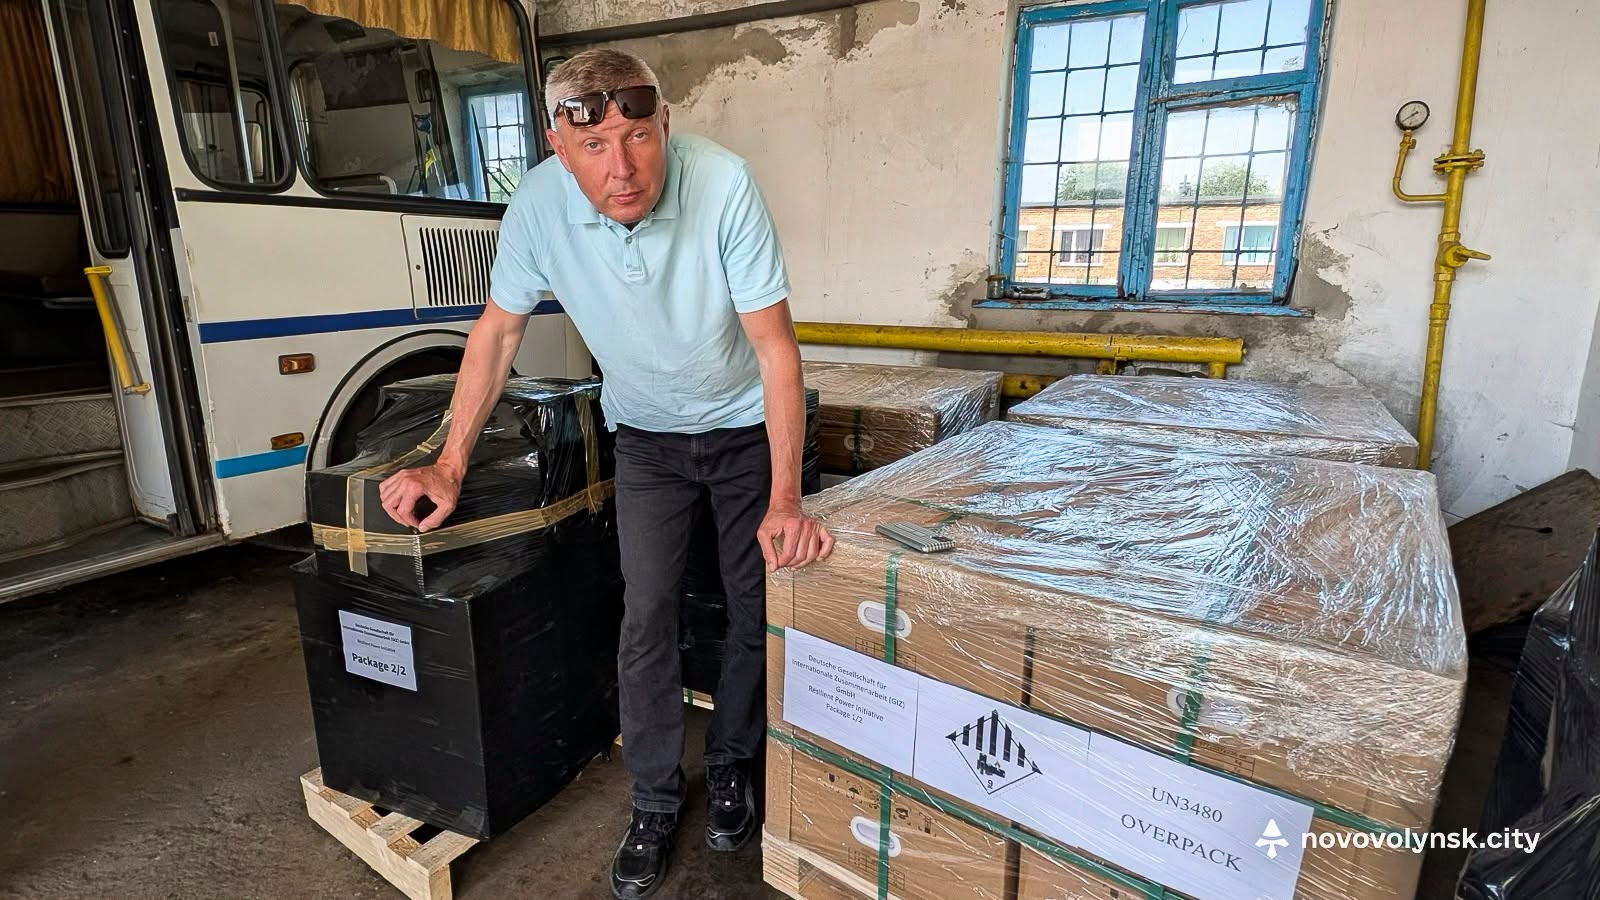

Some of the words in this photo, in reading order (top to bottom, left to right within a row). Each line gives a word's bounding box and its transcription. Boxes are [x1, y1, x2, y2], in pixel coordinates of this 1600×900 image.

[351, 652, 389, 673] Package
[390, 663, 407, 676] 2/2
[808, 654, 836, 671] Deutsche
[837, 666, 876, 686] Gesellschaft
[876, 681, 887, 690] für
[792, 659, 833, 680] Internationale
[834, 672, 888, 702] Zusammenarbeit
[889, 696, 905, 709] (GIZ)
[808, 685, 834, 700] Resilient
[835, 696, 855, 709] Power
[835, 686, 856, 699] GmbH
[826, 703, 851, 719] Package
[852, 713, 863, 724] 1/2
[1152, 787, 1223, 823] UN3480
[1121, 814, 1242, 872] OVERPACK
